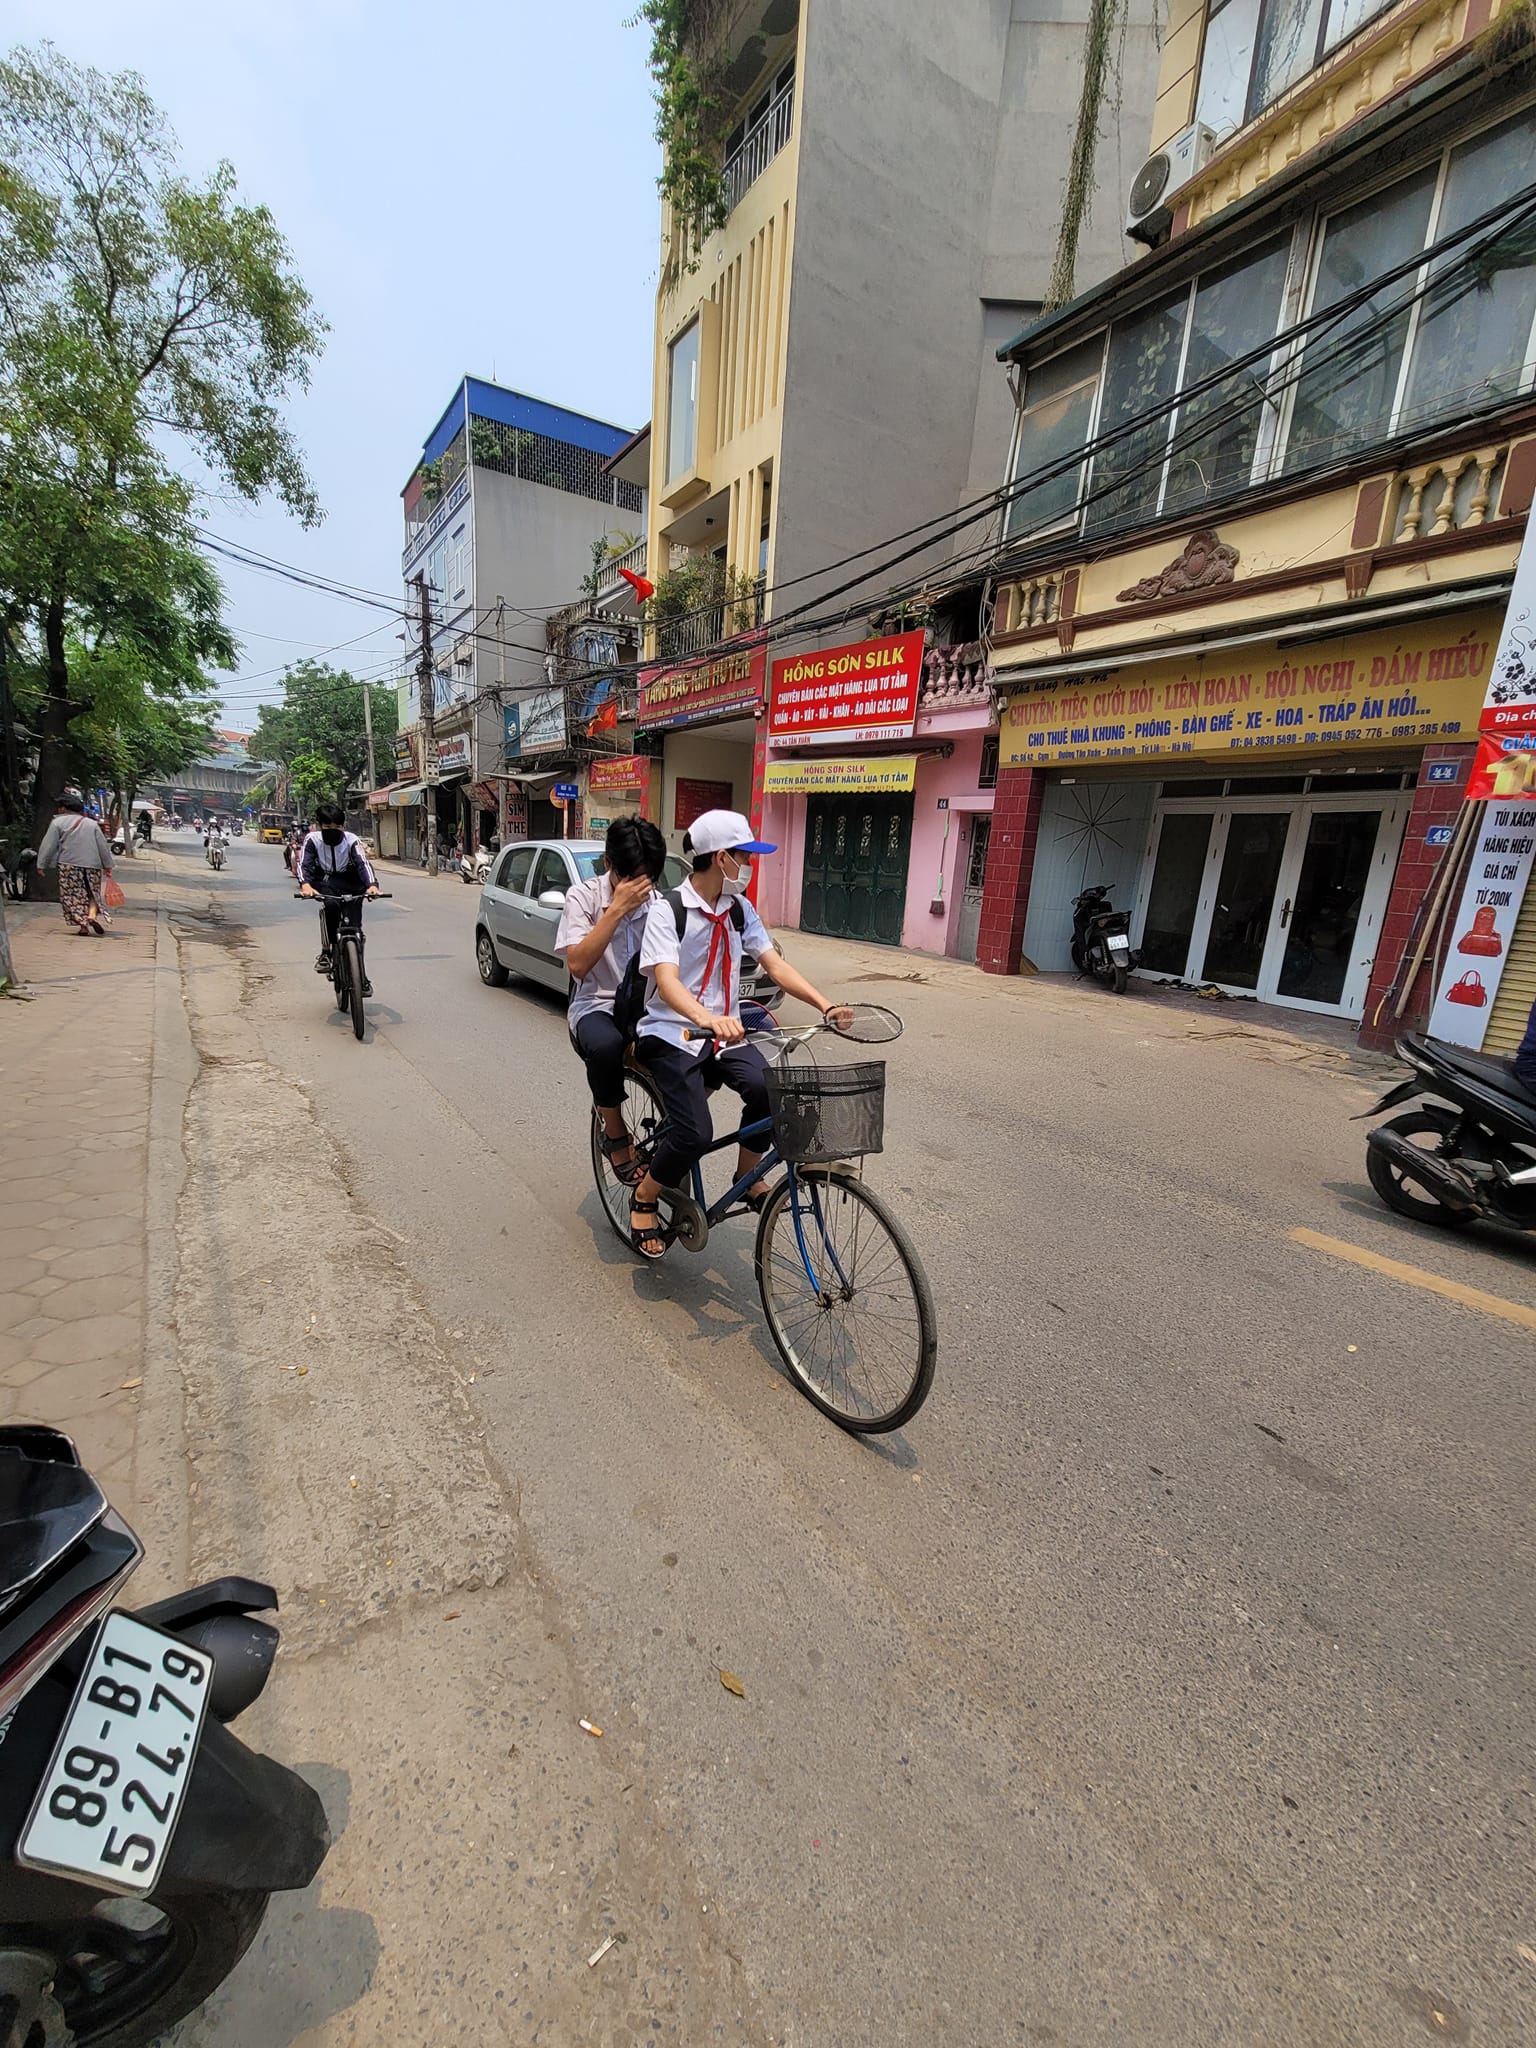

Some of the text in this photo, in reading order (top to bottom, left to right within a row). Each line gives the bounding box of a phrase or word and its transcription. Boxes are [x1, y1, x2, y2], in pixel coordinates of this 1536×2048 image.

[784, 646, 905, 683] HỒNG SƠN SILK
[1009, 629, 1489, 727] CHUYÊN: TIỆC CƯỚI HỎI LIÊN HOAN HỘI NGHỊ ĐÁM HIẾU
[778, 689, 800, 704] CHUYÊN
[814, 684, 828, 699] CÁC
[828, 682, 844, 700] MẶT
[843, 680, 863, 696] HÀNG
[864, 678, 878, 695] LỤA
[880, 675, 890, 690] TƠ
[854, 700, 864, 716] ÁO
[877, 697, 891, 713] CÁC
[892, 697, 909, 714] LOẠI
[1028, 689, 1431, 747] CHO THUÊ NHÀ KHUNG PHÔNG BÀN GHẾ XE HOA TRÁP ĂN HỎI...
[1495, 711, 1519, 725] Địa
[1391, 725, 1415, 737] 0983
[1419, 723, 1438, 735] 385
[1501, 732, 1536, 751] GIẢ
[847, 764, 865, 773] SILK
[1432, 767, 1453, 779] 44
[508, 803, 525, 816] SIM
[1494, 808, 1536, 827] TÚI XÁCH
[1433, 829, 1452, 843] 42
[1483, 834, 1534, 857] HÀNG HIỆU
[1483, 860, 1520, 880] GIÁ CHỈ
[1475, 886, 1512, 907] TỪ 200K
[49, 1645, 152, 1828] 89-B1
[99, 1648, 206, 1873] 524.79
